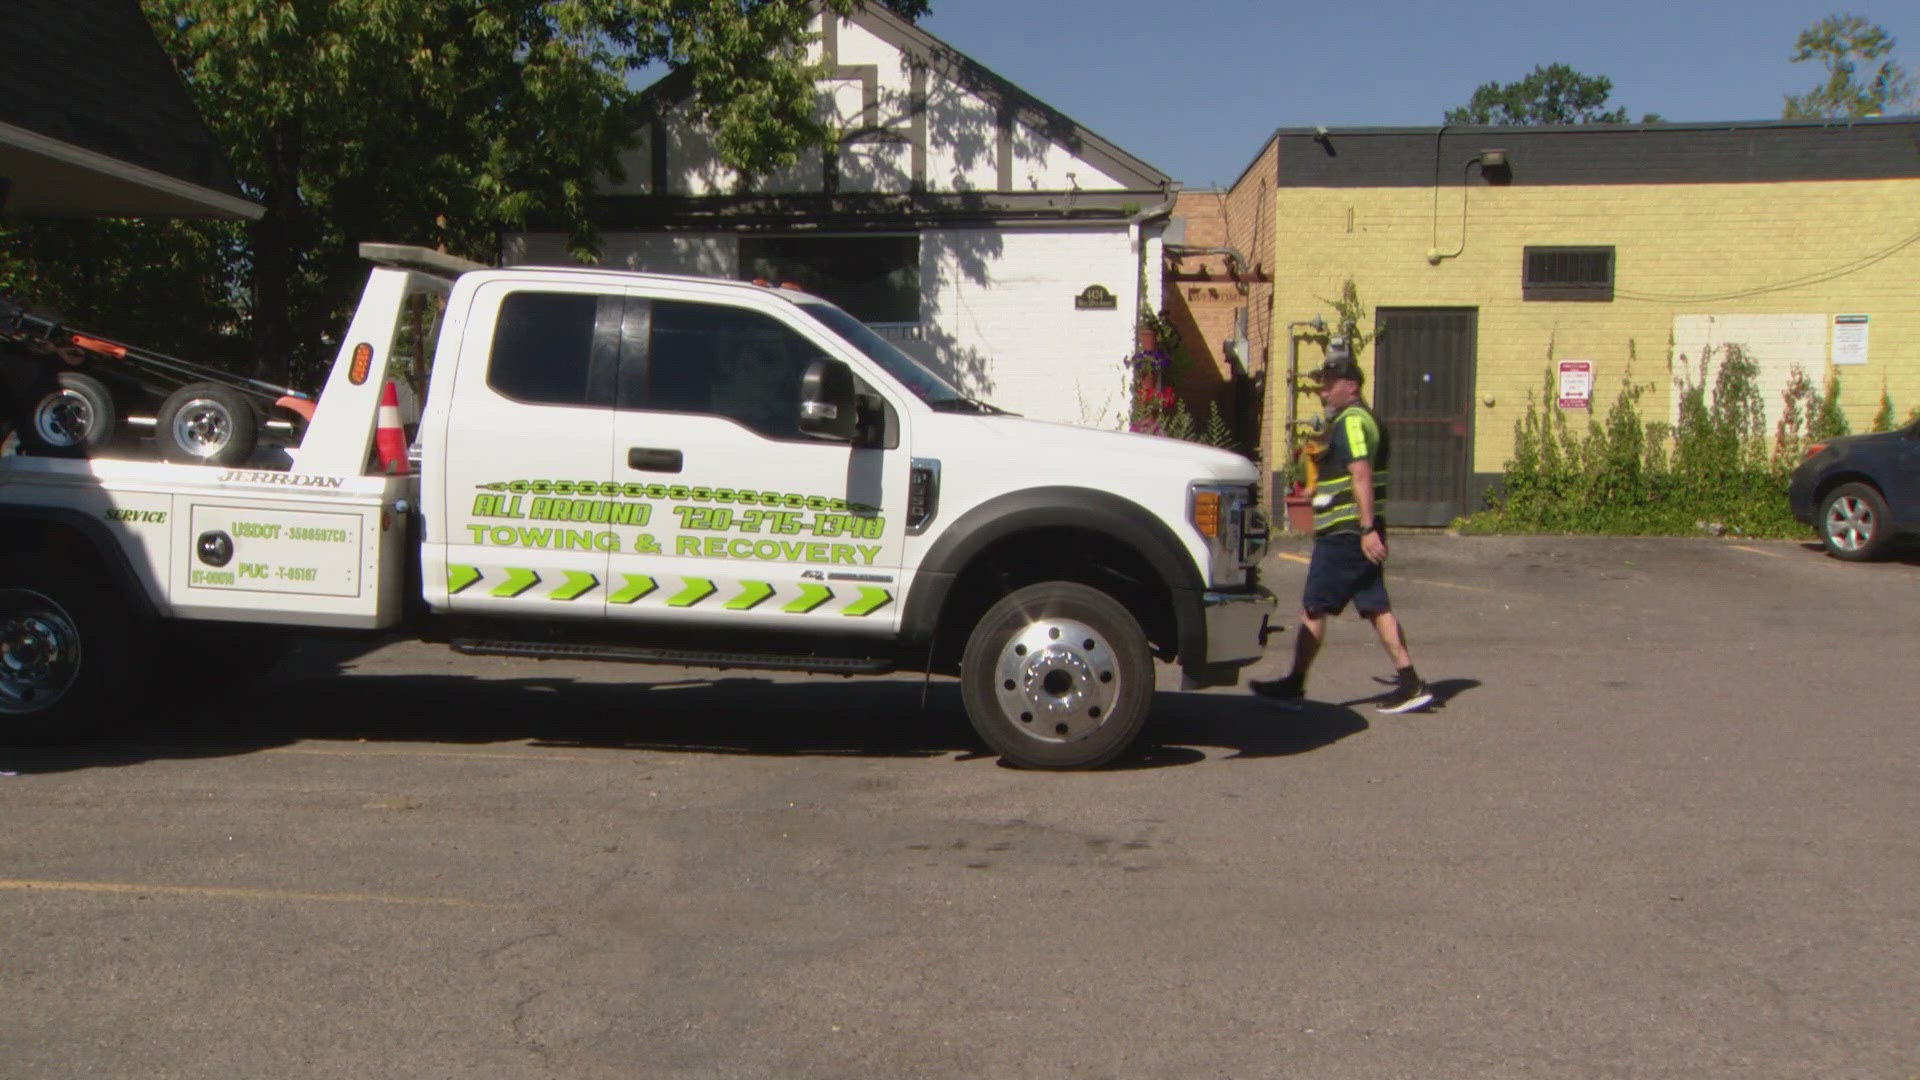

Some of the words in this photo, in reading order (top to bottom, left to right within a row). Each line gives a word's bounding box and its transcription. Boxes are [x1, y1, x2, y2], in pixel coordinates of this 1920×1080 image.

[104, 508, 168, 524] SERVICE
[472, 493, 525, 518] ALL
[529, 497, 653, 527] AROUND
[672, 506, 886, 539] 720-275-1348
[231, 521, 281, 540] USDOT
[467, 524, 621, 553] TOWING
[634, 532, 663, 554] &
[675, 535, 884, 564] RECOVERY
[238, 562, 269, 579] PUC
